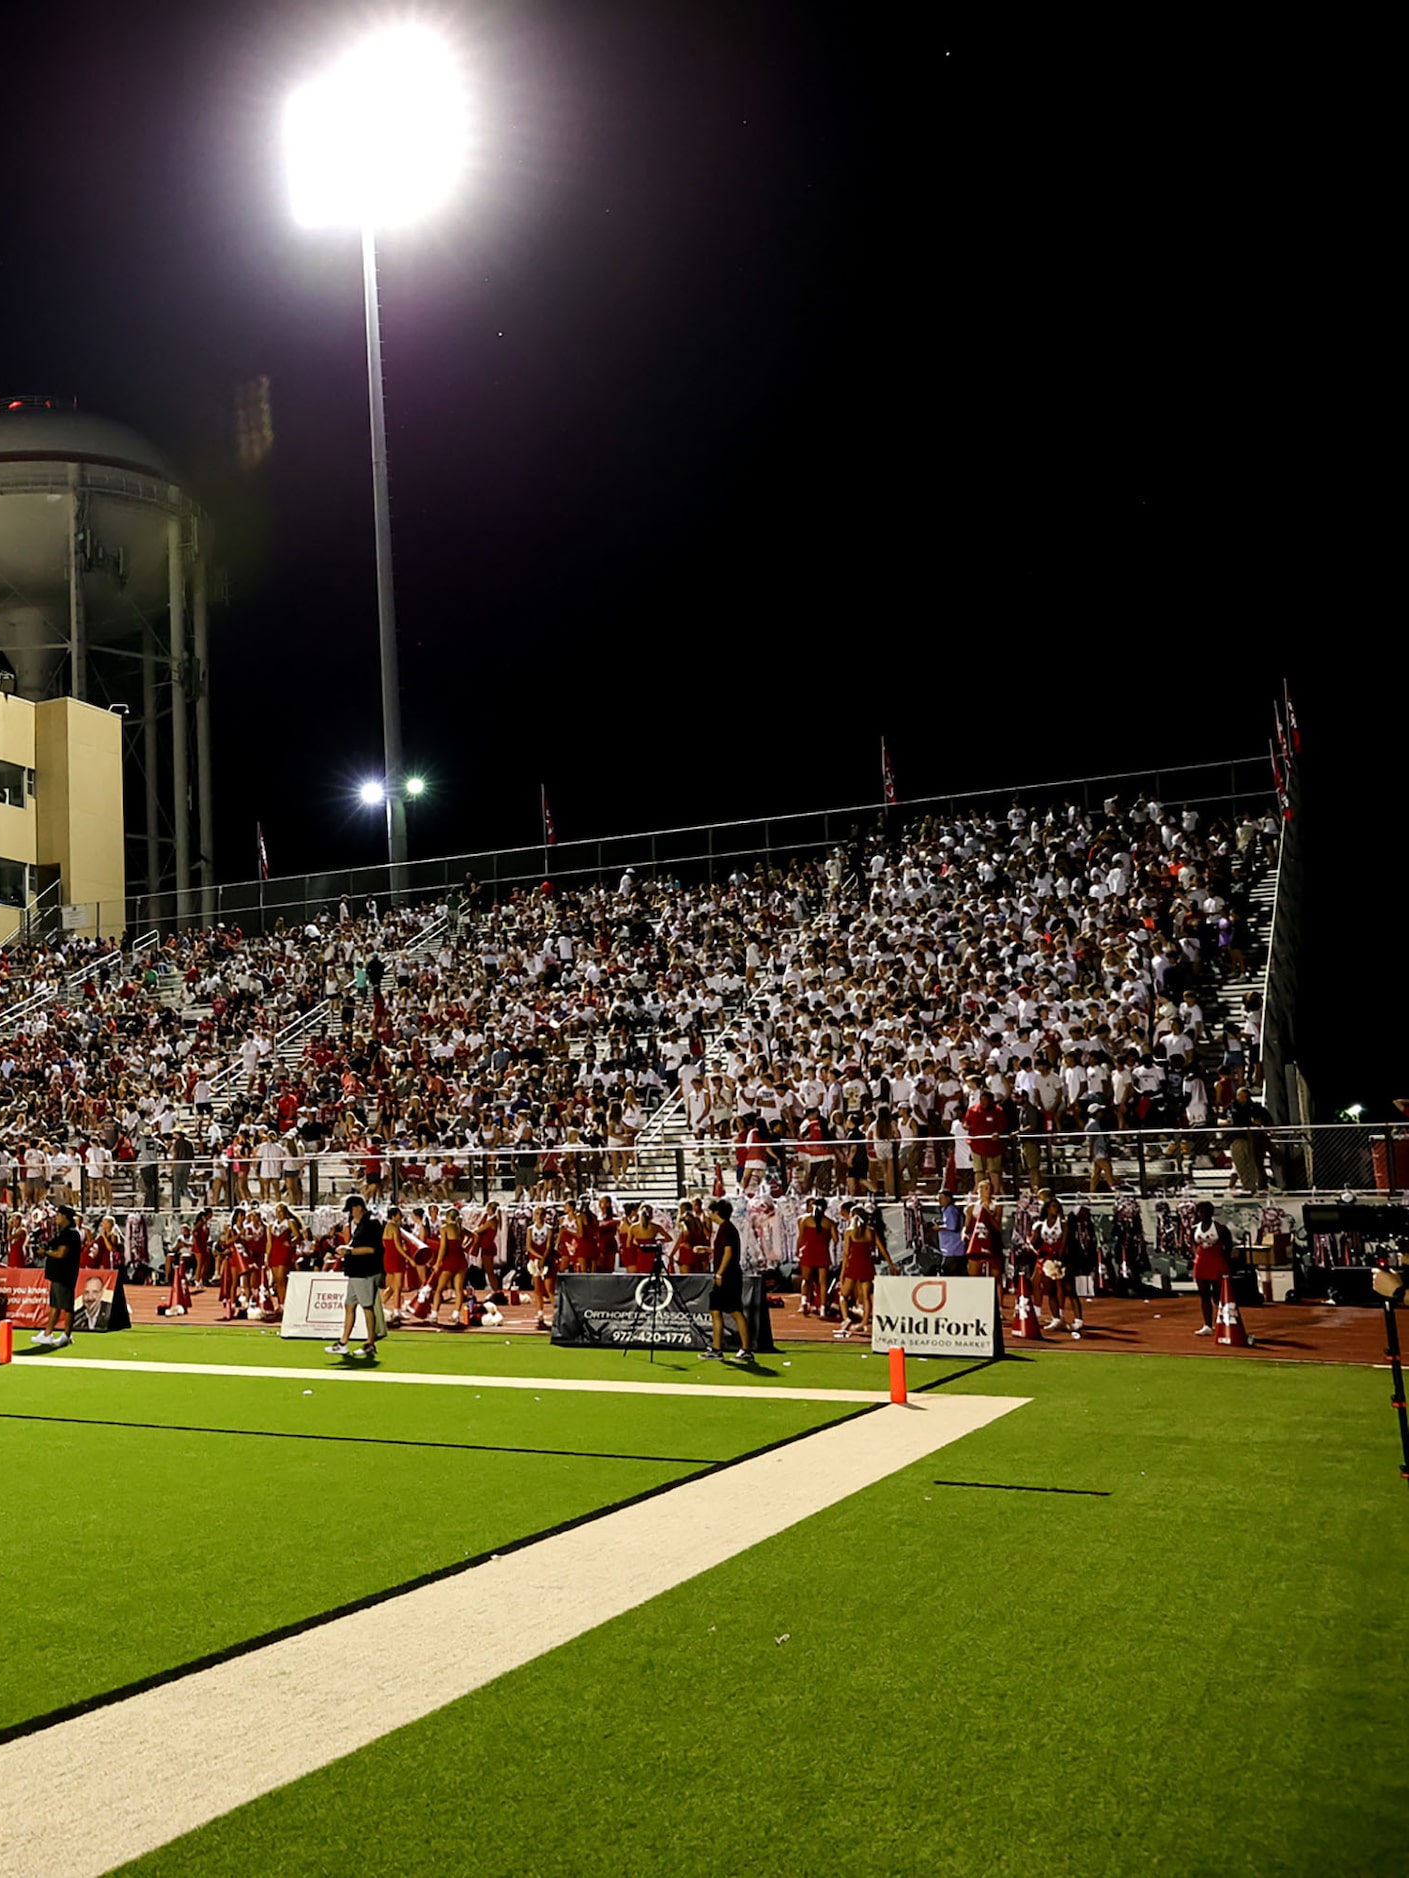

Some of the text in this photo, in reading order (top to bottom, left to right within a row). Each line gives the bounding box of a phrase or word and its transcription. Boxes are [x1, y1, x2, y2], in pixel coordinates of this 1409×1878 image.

[13, 1287, 27, 1296] you
[316, 1293, 344, 1301] TERRY
[314, 1301, 343, 1310] COSTA
[876, 1315, 988, 1337] Wild Fork
[909, 1339, 953, 1347] SEAFOOD
[955, 1340, 992, 1348] MARKET
